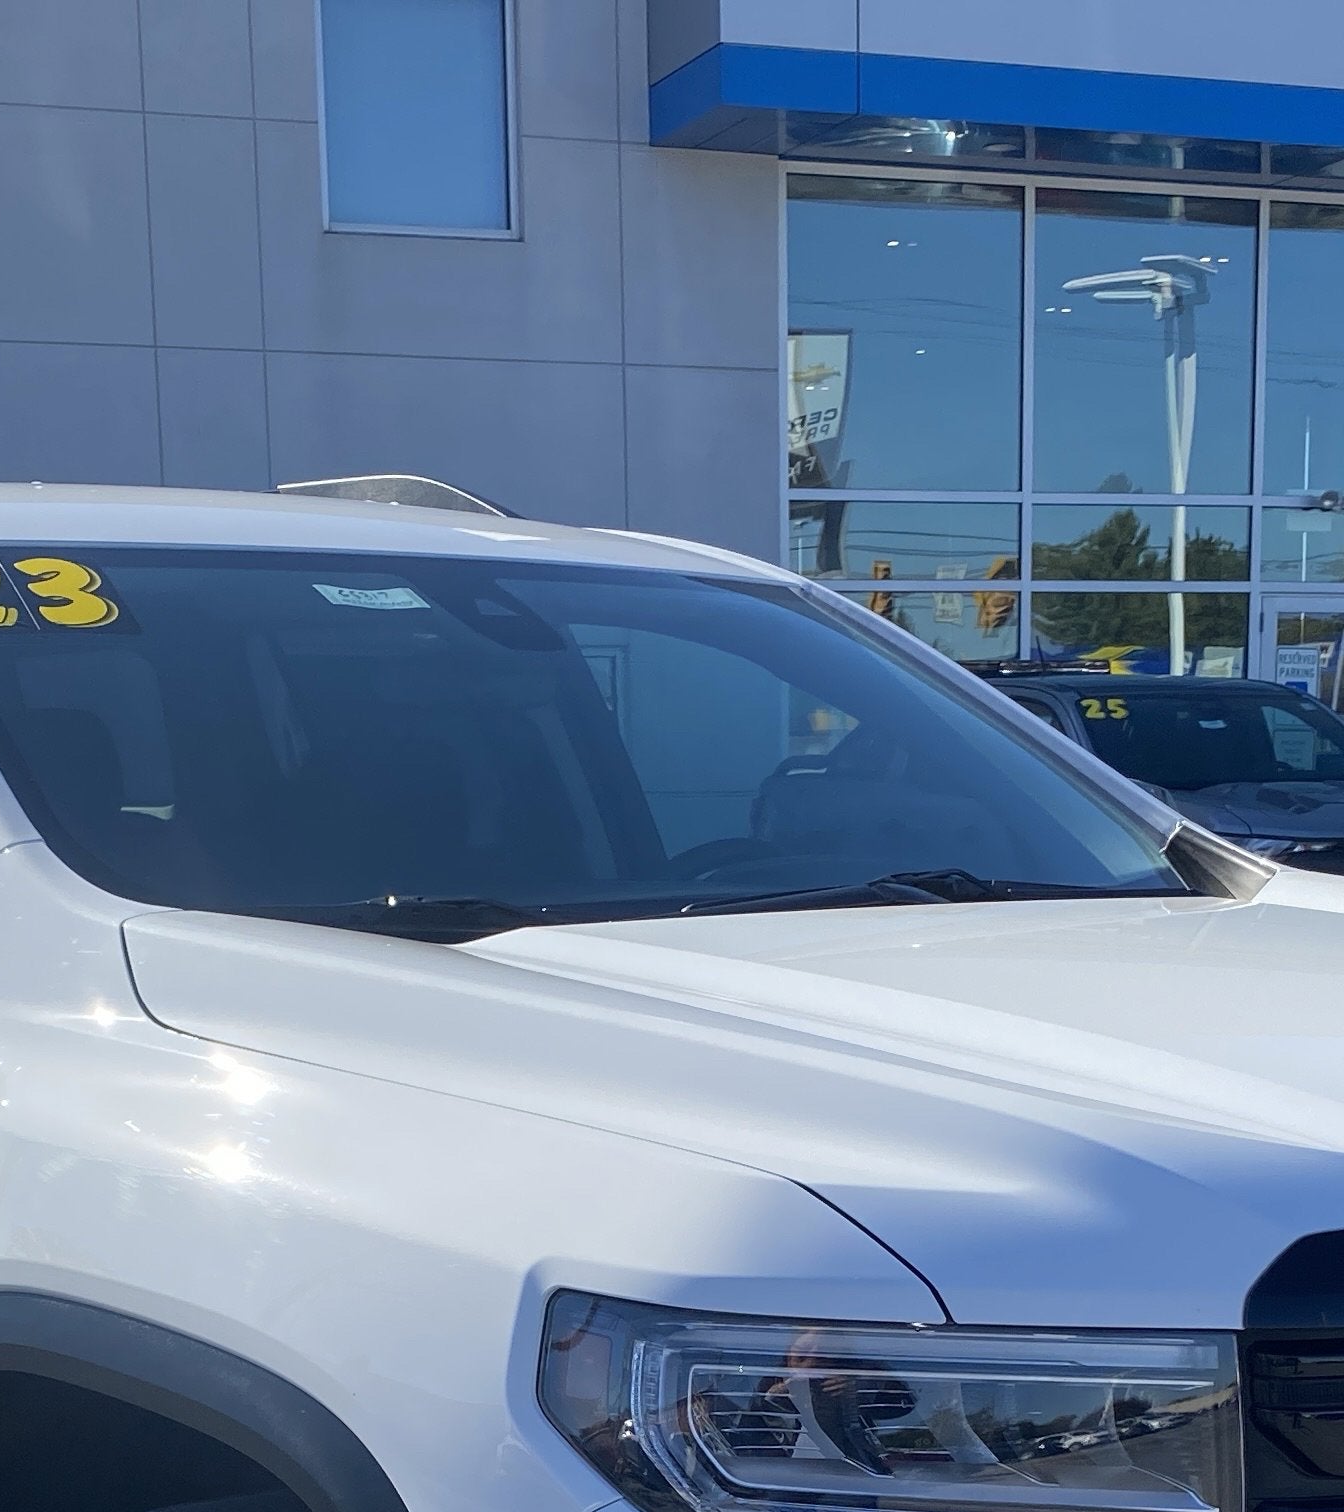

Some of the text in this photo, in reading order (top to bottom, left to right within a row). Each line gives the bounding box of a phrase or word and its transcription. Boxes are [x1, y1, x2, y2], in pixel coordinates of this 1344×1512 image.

[1278, 653, 1316, 665] RESERVED
[1278, 667, 1315, 678] PARKING
[1079, 698, 1129, 719] 25
